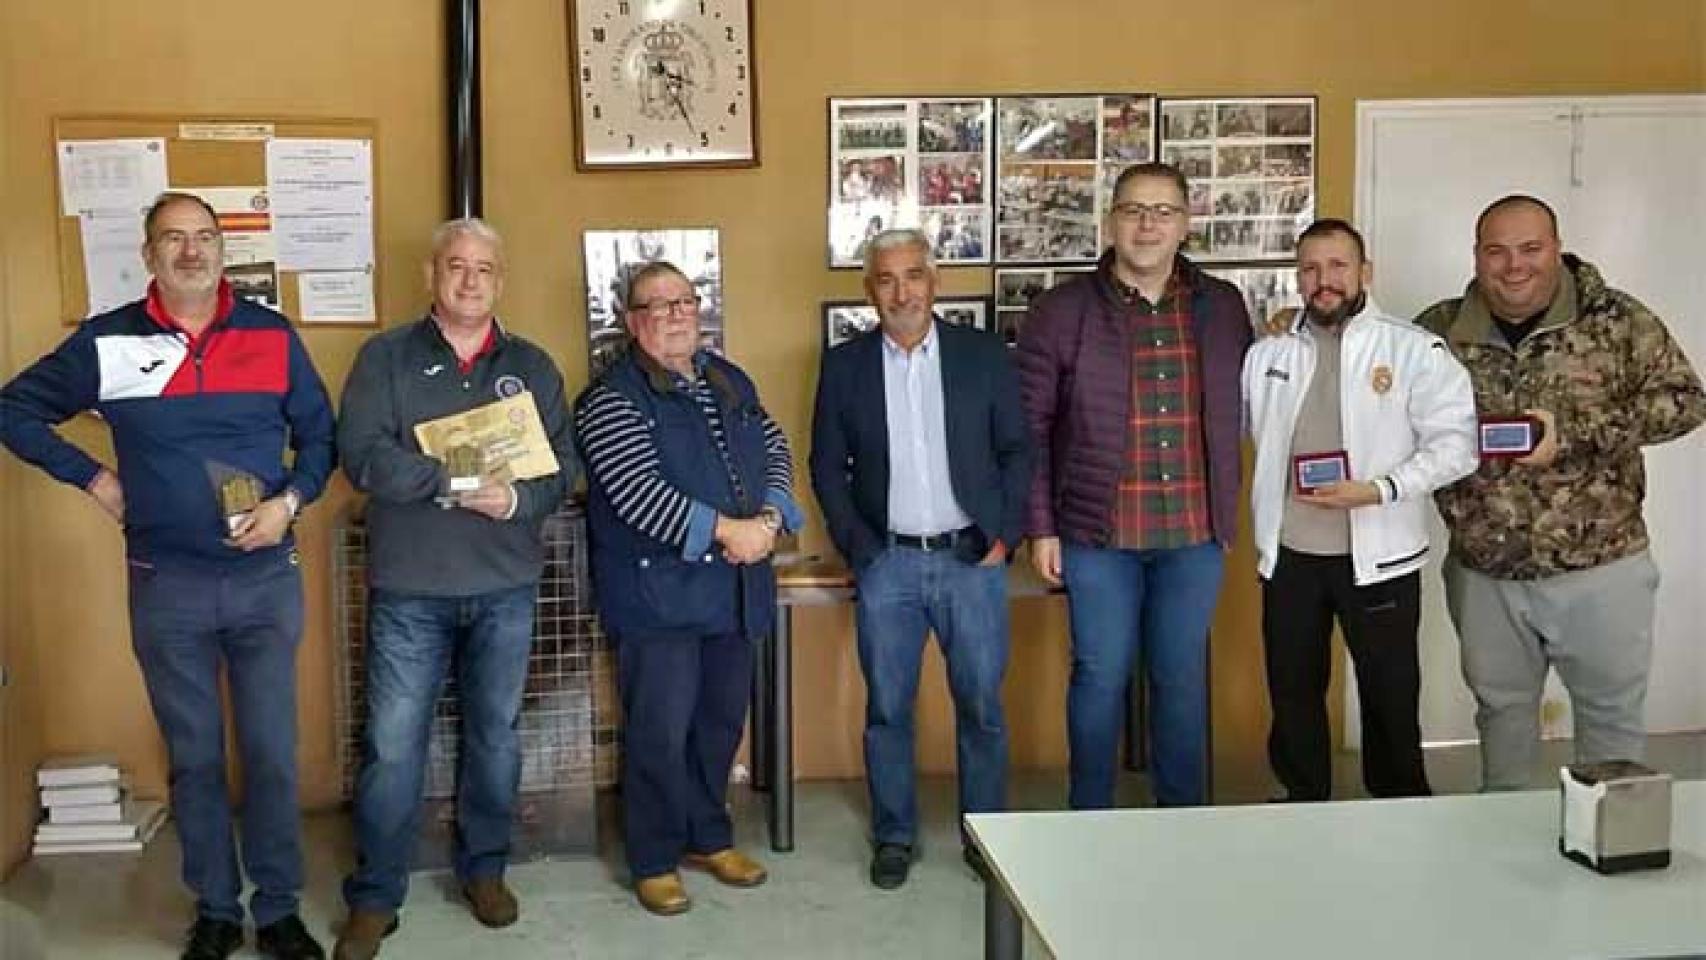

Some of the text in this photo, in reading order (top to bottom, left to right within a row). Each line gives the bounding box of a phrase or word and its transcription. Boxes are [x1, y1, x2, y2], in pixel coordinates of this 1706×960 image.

[728, 102, 736, 115] 4
[627, 134, 634, 148] 7
[701, 131, 708, 147] 5
